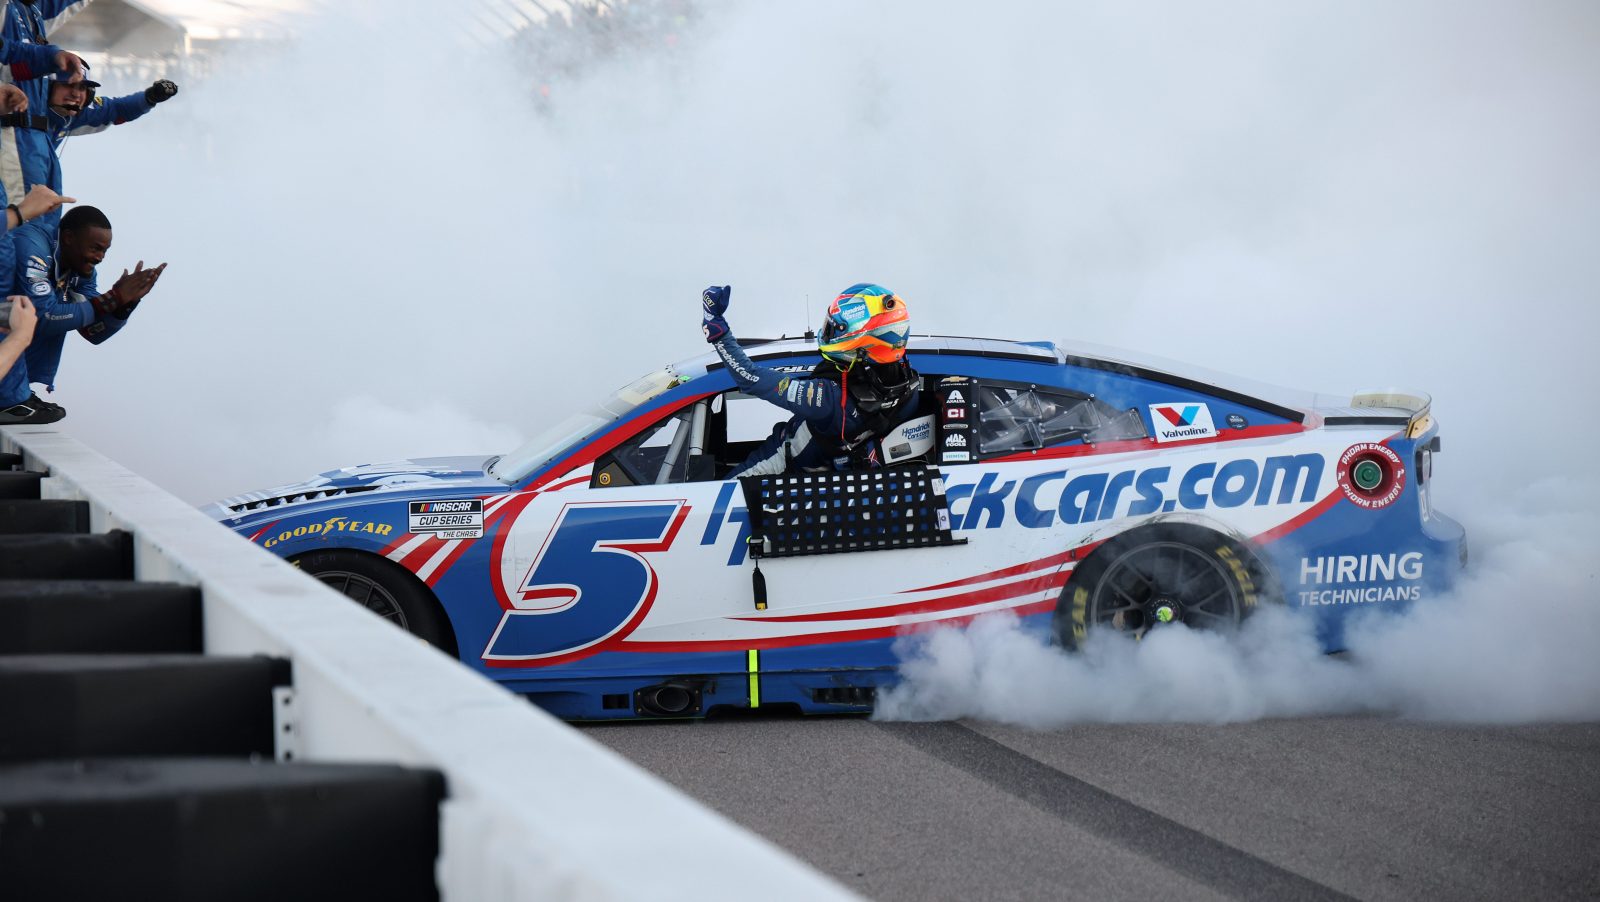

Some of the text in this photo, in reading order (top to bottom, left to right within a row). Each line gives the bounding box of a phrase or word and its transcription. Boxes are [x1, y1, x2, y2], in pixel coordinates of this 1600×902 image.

[945, 433, 966, 443] MAC
[1162, 427, 1208, 438] Valvoline
[1368, 443, 1401, 463] ENERGY
[1371, 481, 1402, 508] ENERGY
[432, 502, 472, 512] NASCAR
[700, 453, 1326, 566] HckCars.com
[419, 515, 473, 526] CUP SERIES
[264, 516, 393, 548] GOODYEAR
[1299, 552, 1424, 585] HIRING
[481, 499, 693, 668] 5
[1299, 586, 1421, 607] TECHNICIANS
